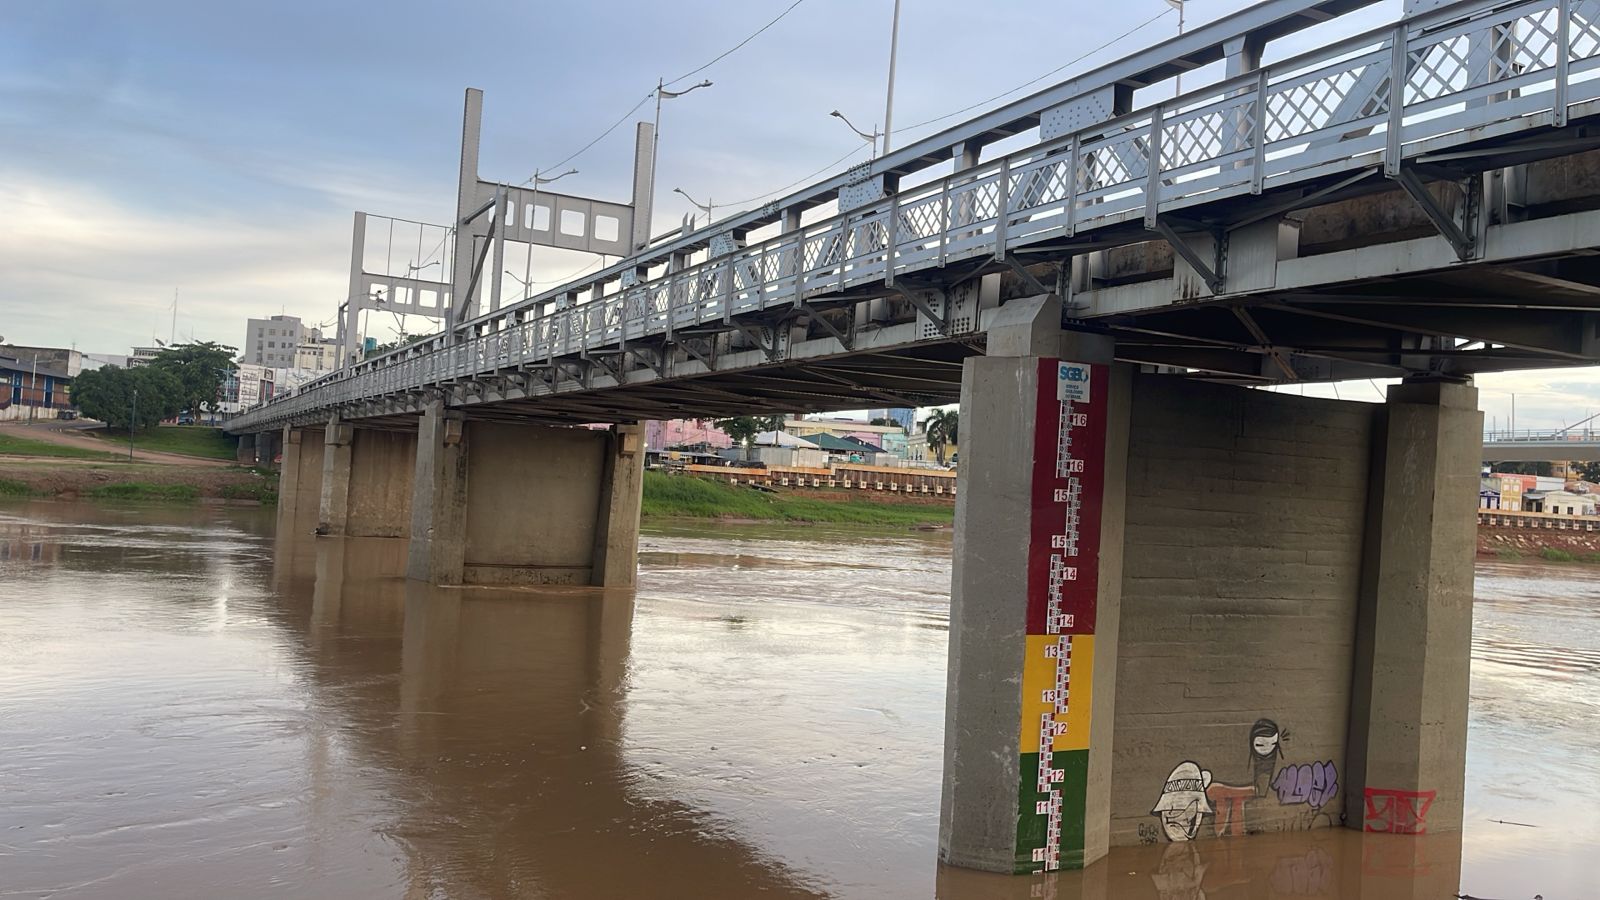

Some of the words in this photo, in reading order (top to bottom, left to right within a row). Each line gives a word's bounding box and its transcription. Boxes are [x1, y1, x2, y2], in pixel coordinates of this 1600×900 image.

[1073, 415, 1086, 426] 16
[1071, 461, 1083, 471] 16
[1056, 490, 1068, 501] 15
[1053, 536, 1065, 547] 15
[1064, 568, 1076, 580] 14
[1062, 615, 1073, 626] 14
[1046, 646, 1058, 657] 13
[1043, 691, 1055, 702] 13
[1055, 723, 1067, 735] 12
[1052, 770, 1064, 782] 12
[1037, 802, 1048, 813] 11
[1034, 849, 1046, 860] 11
